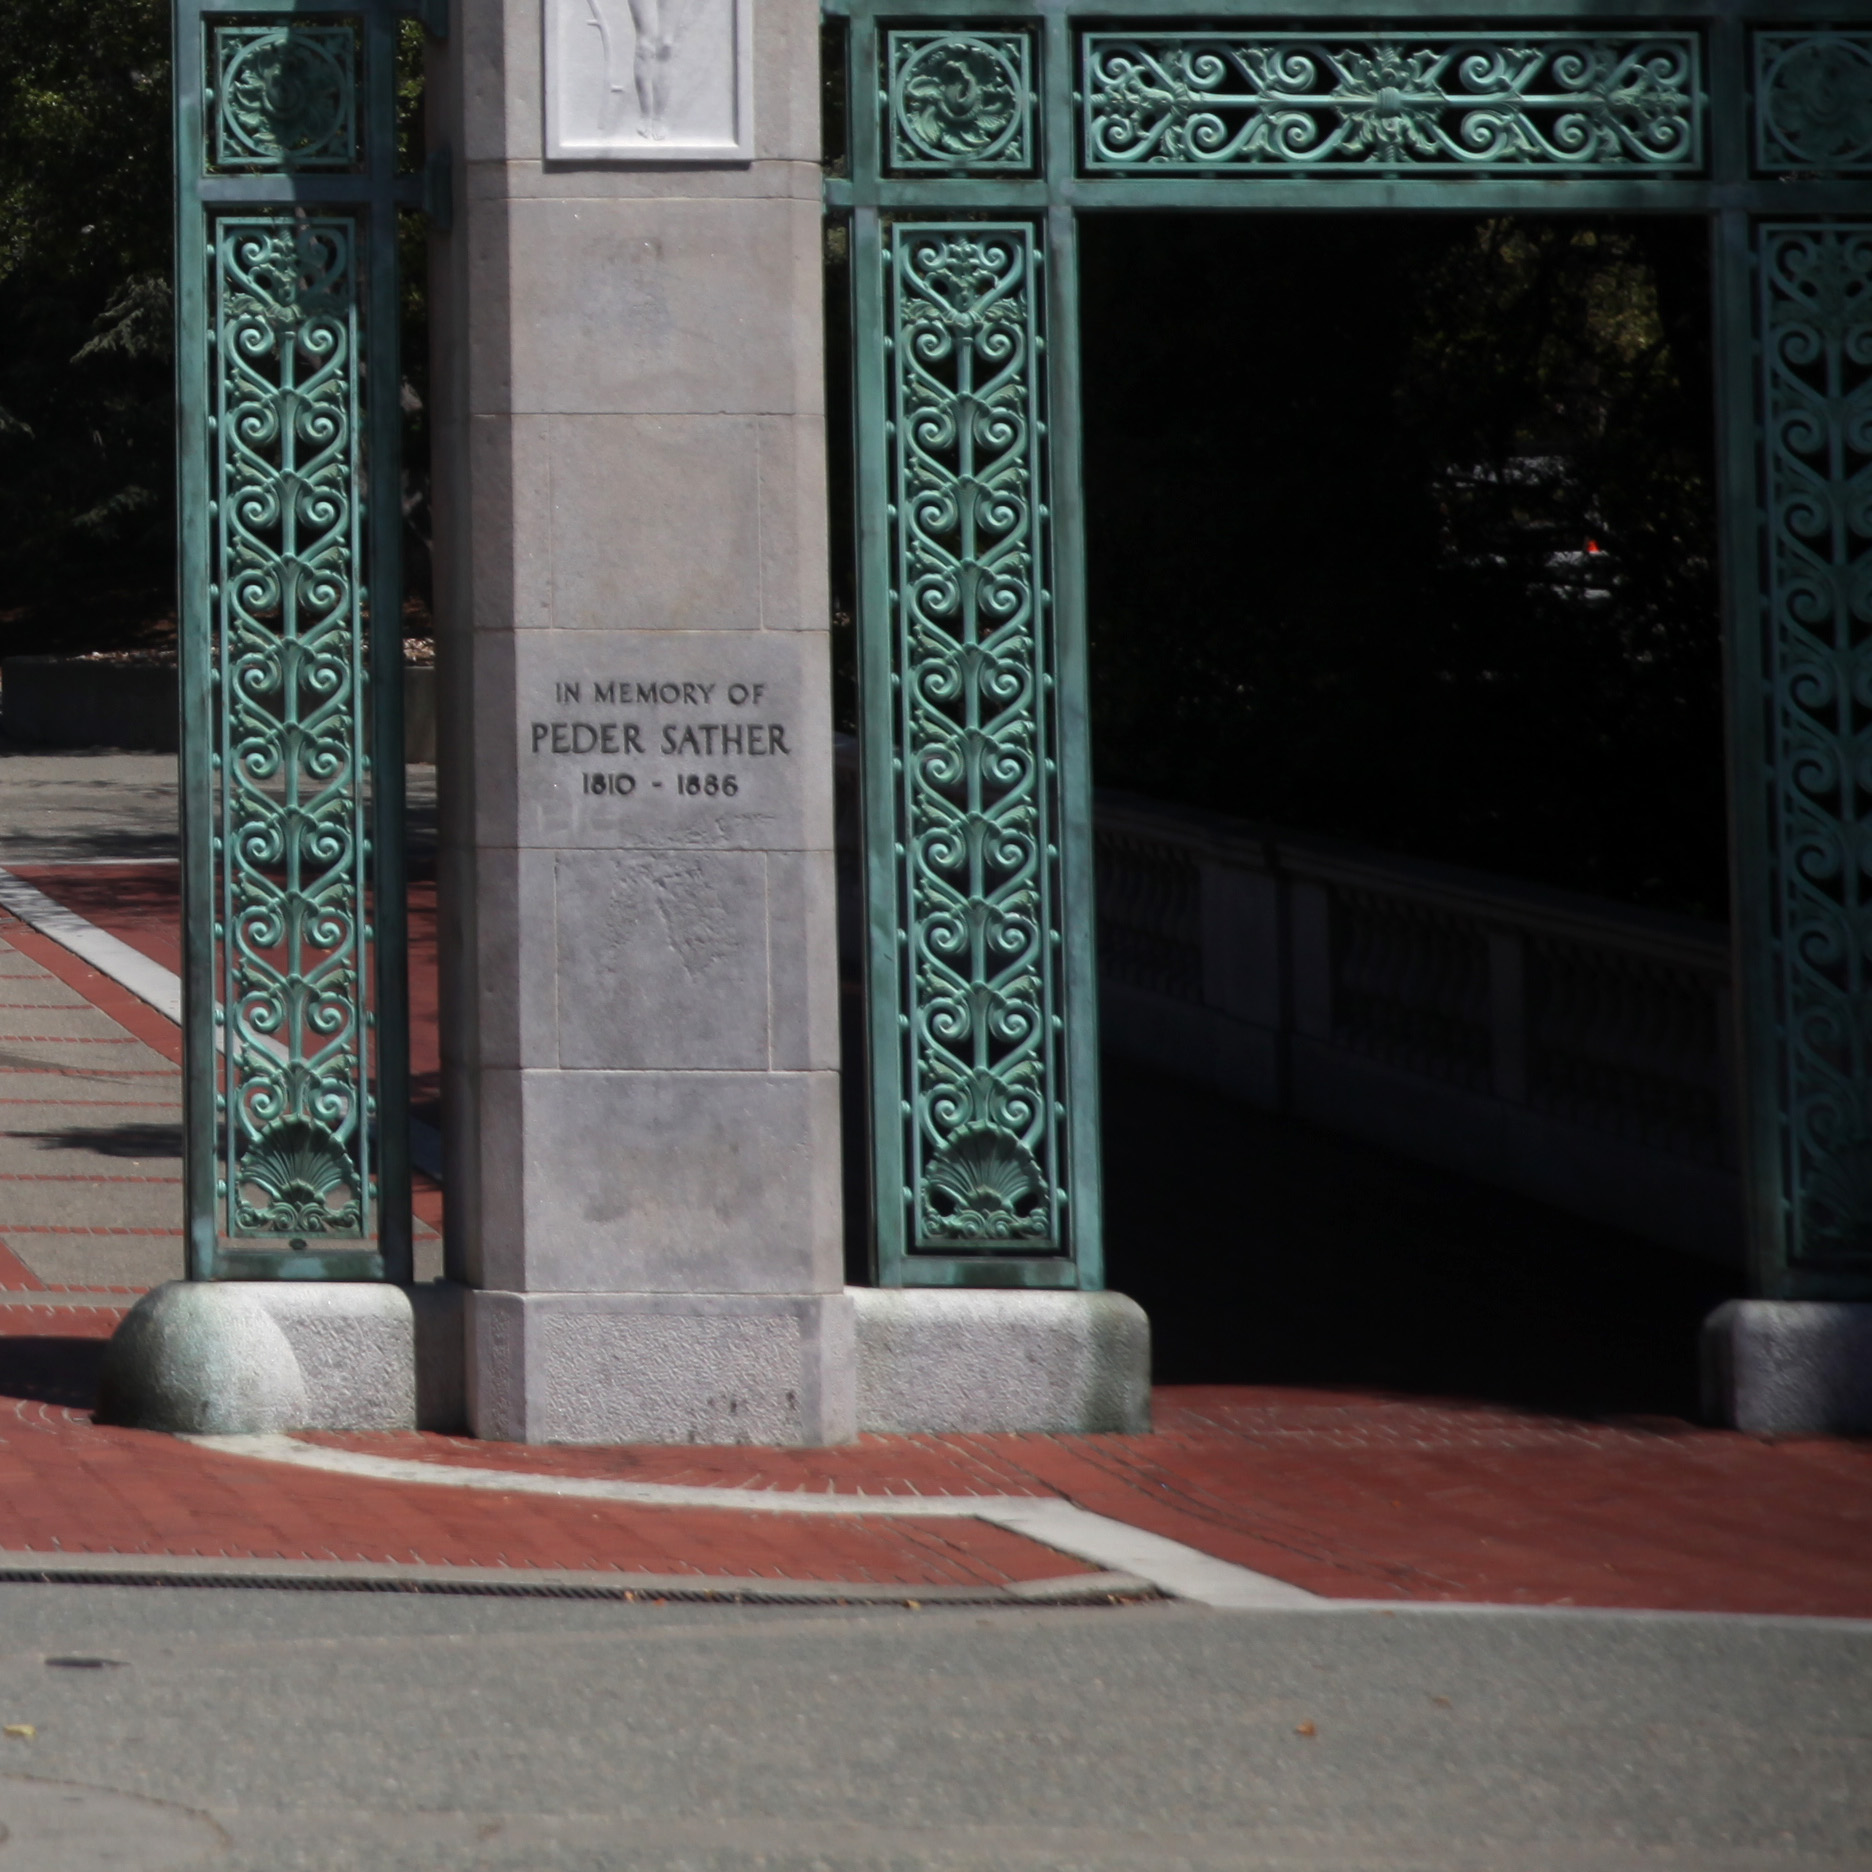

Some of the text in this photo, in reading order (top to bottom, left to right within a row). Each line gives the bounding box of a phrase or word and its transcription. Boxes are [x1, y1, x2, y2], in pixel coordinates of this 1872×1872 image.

[556, 681, 767, 705] IN MEMORY OF
[530, 722, 791, 756] PEDER SATHER
[581, 771, 636, 796] 1810
[676, 772, 739, 796] 1886
